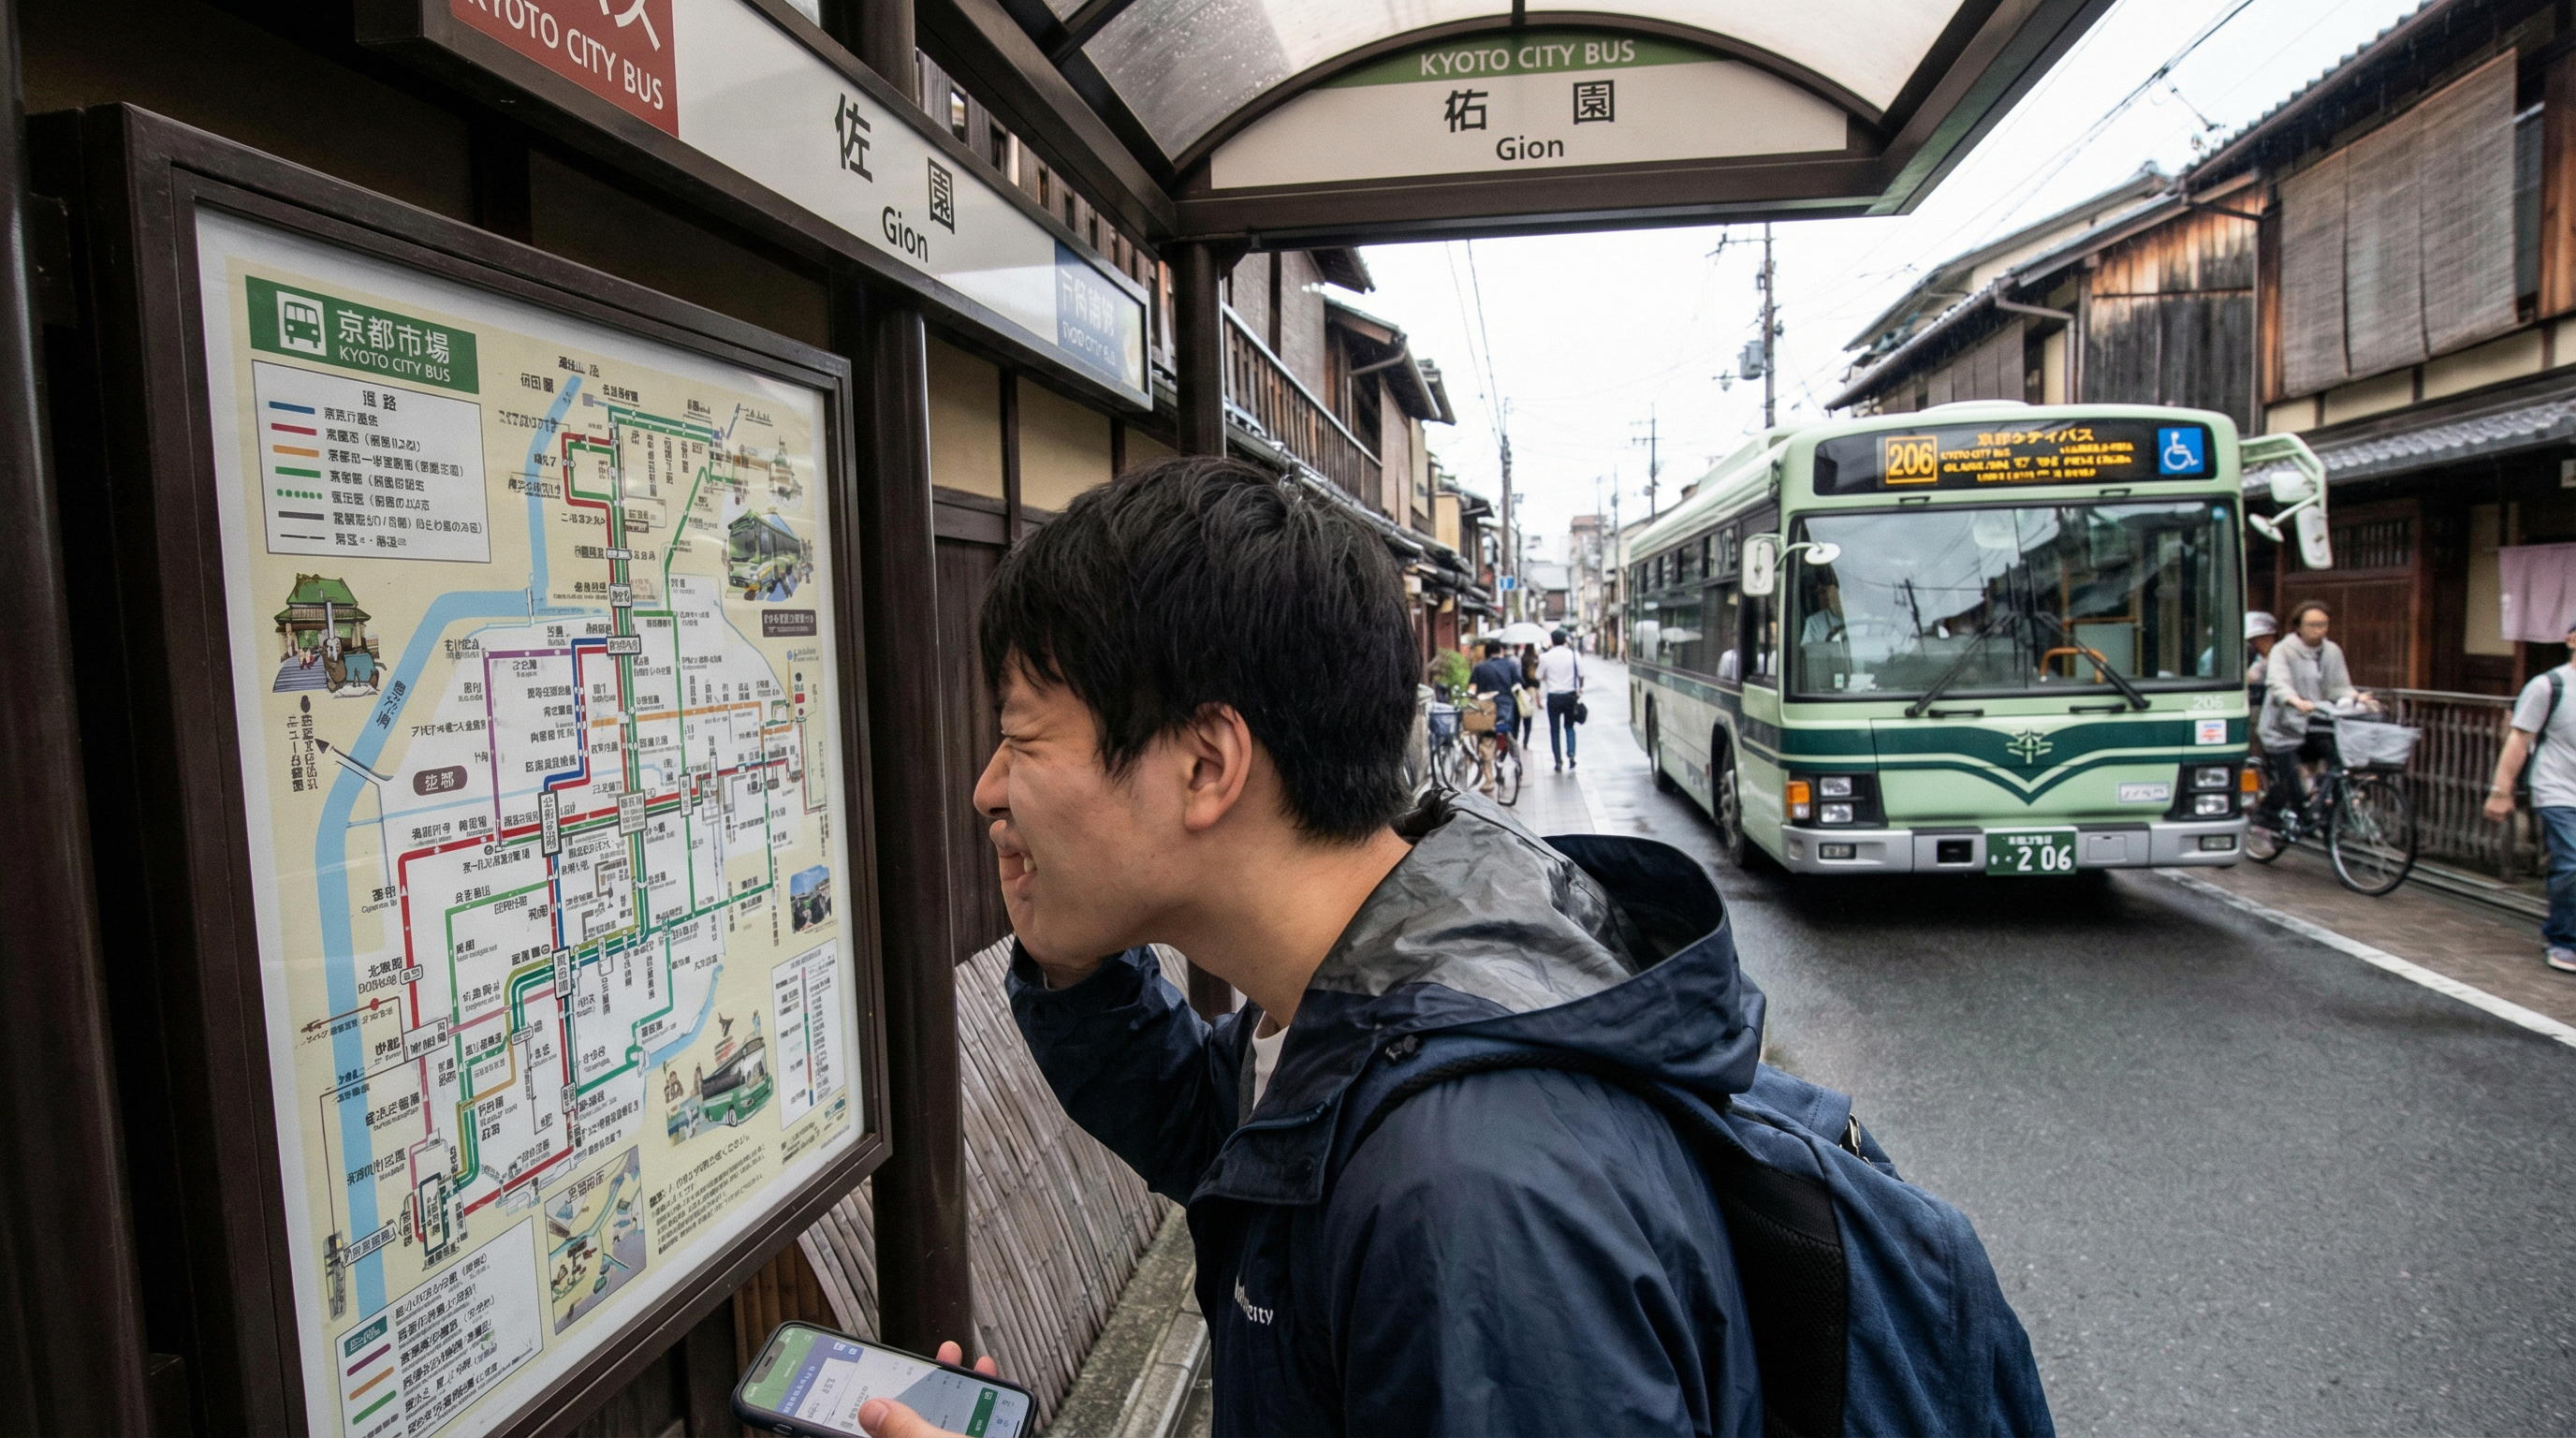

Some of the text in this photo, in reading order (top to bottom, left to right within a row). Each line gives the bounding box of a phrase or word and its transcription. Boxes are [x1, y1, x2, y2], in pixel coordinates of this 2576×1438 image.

[566, 28, 616, 82] CITY
[623, 58, 664, 110] BUS
[1421, 39, 1635, 76] KYOTO CITY BUS
[1496, 135, 1564, 161] Gion
[882, 205, 929, 263] Gion
[337, 310, 449, 364] 京都市場
[339, 345, 450, 382] KYOTO CITY BUS
[1889, 442, 1934, 476] 206
